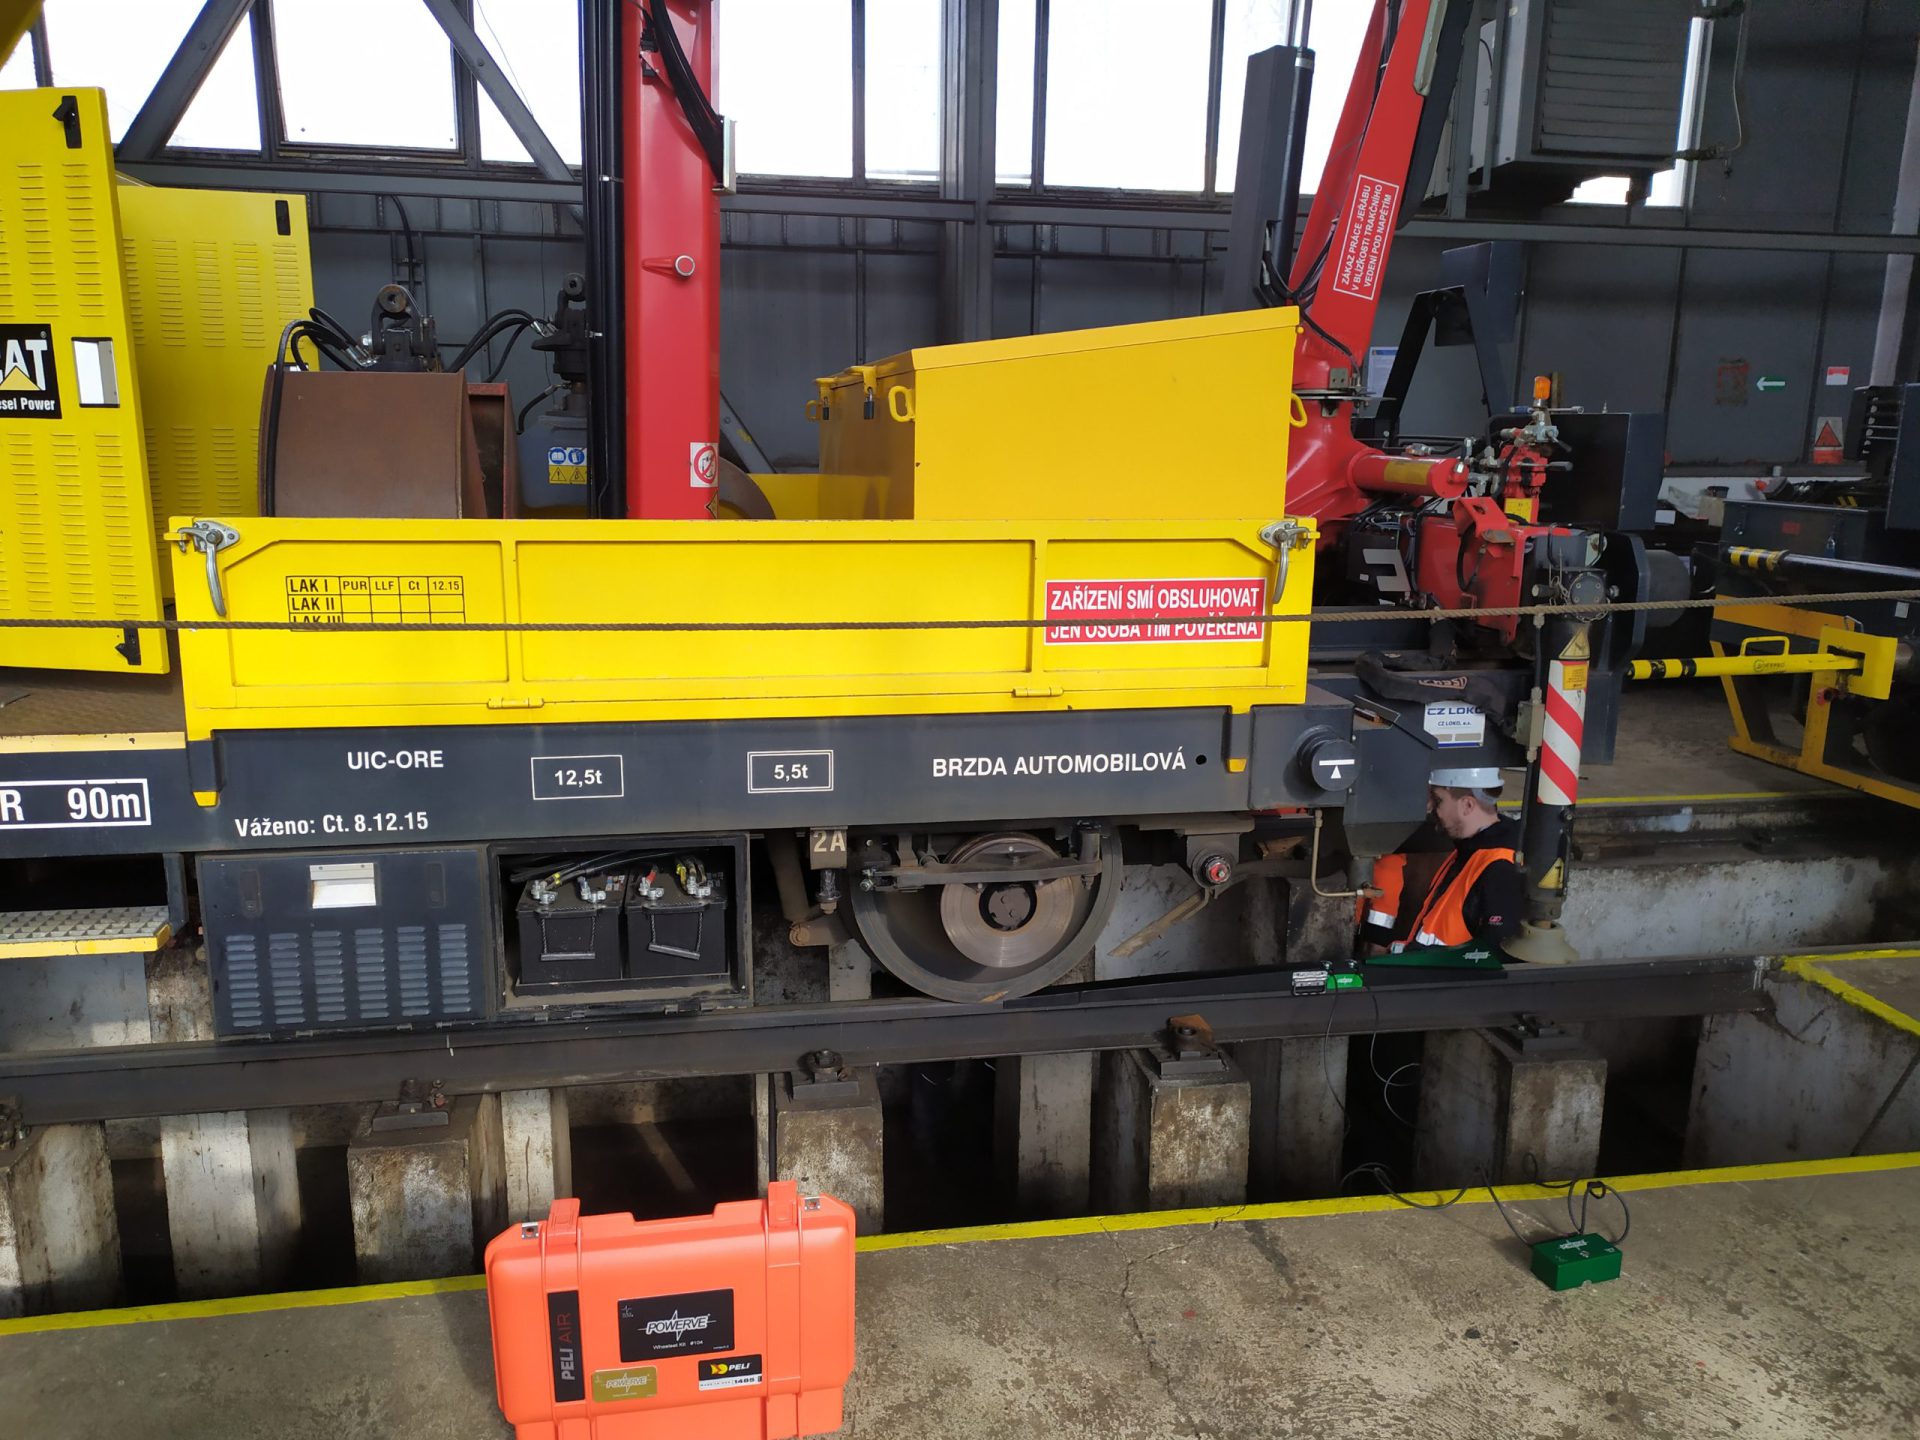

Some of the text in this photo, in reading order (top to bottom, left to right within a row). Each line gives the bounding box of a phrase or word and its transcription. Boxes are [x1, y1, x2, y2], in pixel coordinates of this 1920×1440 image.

[1341, 185, 1371, 285] ZÁKAZ PRÁCE JEŘÁBU
[1351, 283, 1359, 291] V
[1364, 184, 1383, 236] TRAKČNÍHO
[1364, 194, 1392, 287] VEDENÍ POD NAPĚTÍM
[0, 339, 48, 390] AT
[20, 397, 55, 411] Power
[290, 579, 460, 593] LAK I PUR LLF Ct 12.15
[292, 597, 335, 611] LAK II
[1051, 585, 1260, 611] ZAŘÍZENÍ SMÍ OBSLUHOVAT
[1427, 708, 1446, 716] CZ
[347, 750, 445, 770] UIC-ORE
[933, 746, 1187, 777] BRZDA AUTOMOBILOVÁ
[554, 769, 603, 788] 12,5t
[773, 764, 809, 783] 5,5t
[0, 787, 142, 821] R 90m
[234, 811, 429, 837] Váženo: Ct. 8.12.15
[645, 1315, 709, 1335] POWERVE
[557, 1313, 575, 1380] PELI AIR
[728, 1362, 751, 1371] PELI
[605, 1375, 648, 1389] POWERVE
